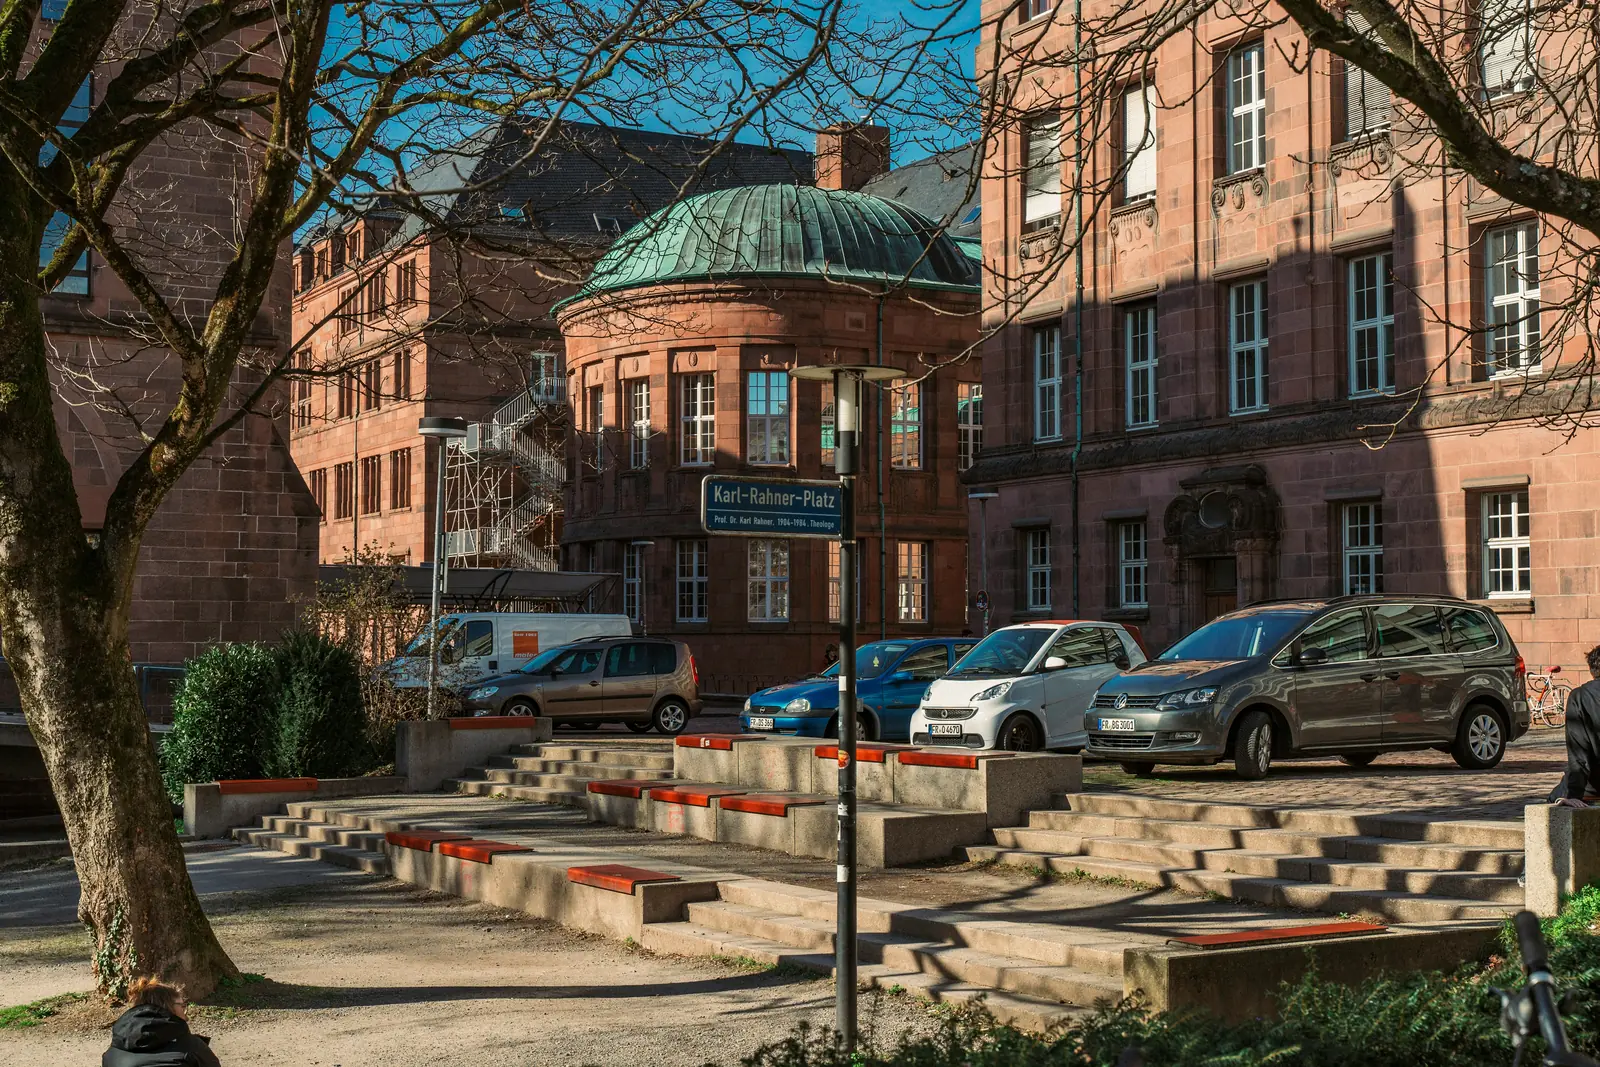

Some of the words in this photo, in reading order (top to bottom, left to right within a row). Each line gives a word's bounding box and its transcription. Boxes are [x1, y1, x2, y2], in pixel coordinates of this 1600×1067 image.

[714, 485, 835, 508] Karl-Rahner-Platz
[714, 515, 727, 524] Prof.
[729, 516, 738, 524] Dr.
[740, 516, 751, 525] Karl
[810, 519, 834, 530] Theologe
[932, 725, 939, 733] FR
[1102, 719, 1109, 729] FR
